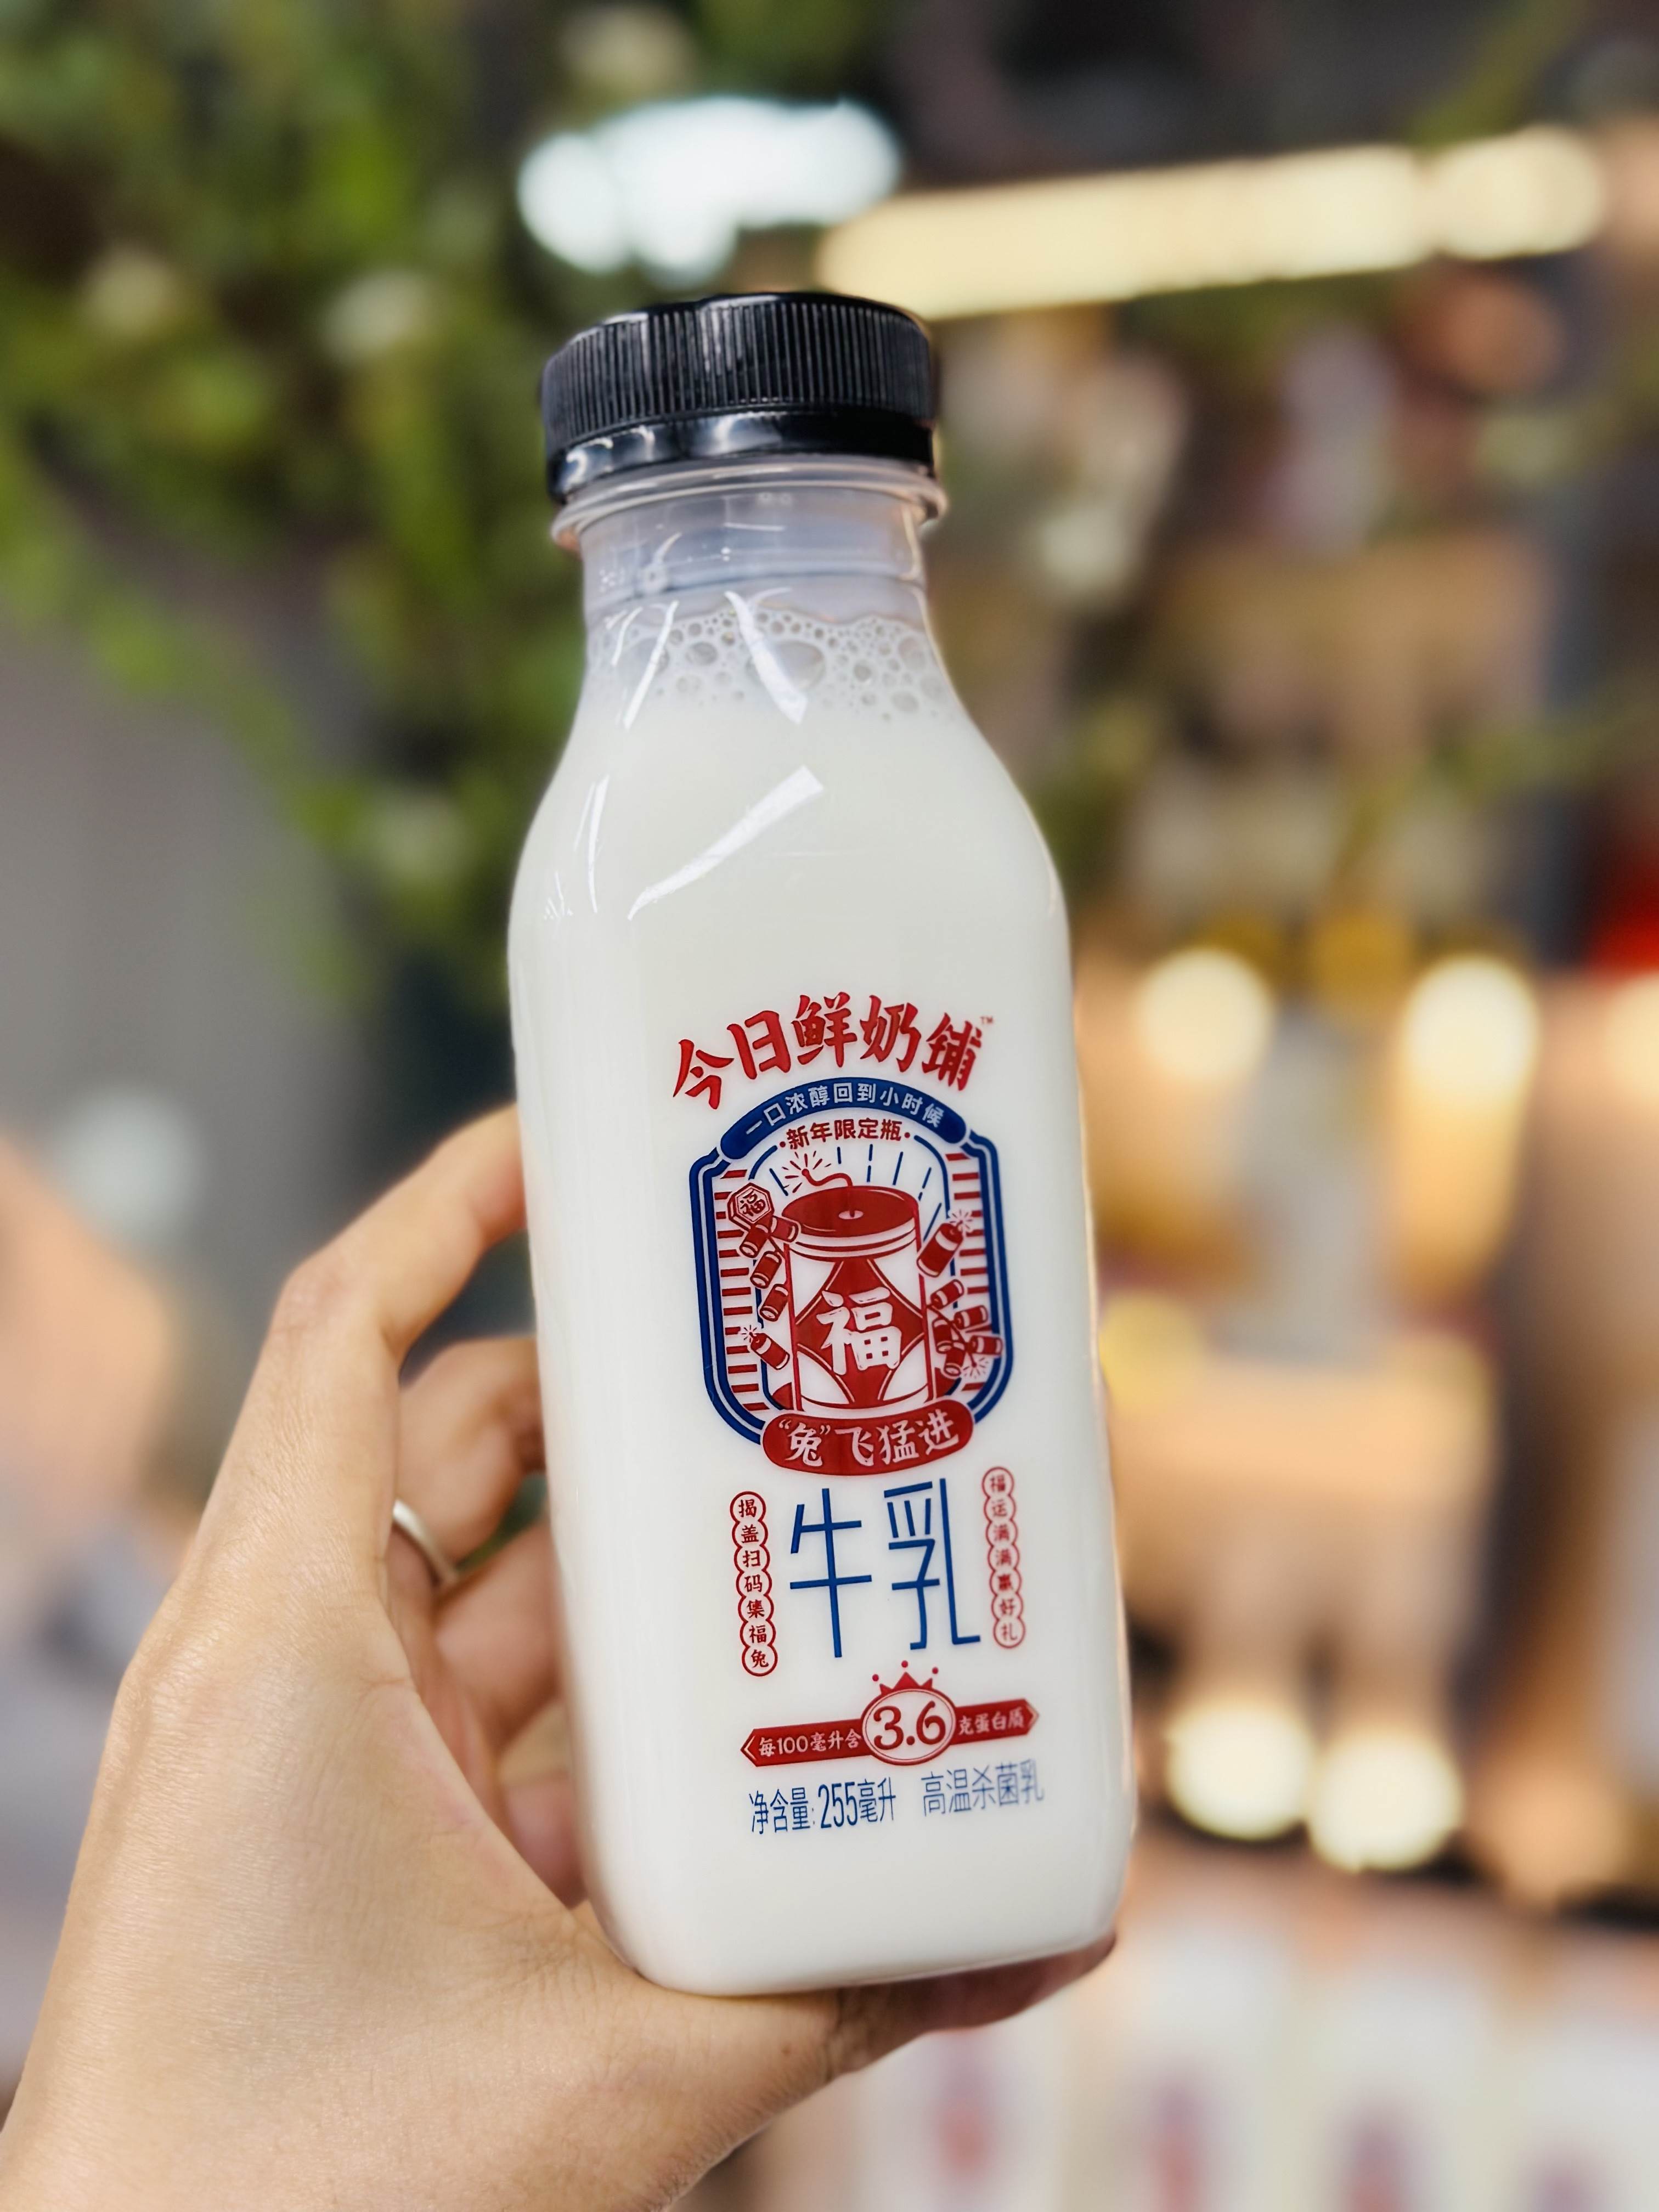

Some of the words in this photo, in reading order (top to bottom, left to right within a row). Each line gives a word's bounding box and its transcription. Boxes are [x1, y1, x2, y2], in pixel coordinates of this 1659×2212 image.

[673, 992, 983, 1109] 今日鲜奶铺
[746, 1082, 944, 1135] 一口浓醇回到小时候
[786, 1118, 902, 1150] 新年限定瓶
[816, 1287, 902, 1376] 福
[737, 1498, 770, 1669] 揭盖扫码集福兔
[790, 1478, 981, 1658] 牛乳
[758, 1730, 862, 1757] 每100毫升含
[873, 1701, 946, 1750] 3.6
[958, 1707, 1025, 1736] 克蛋白质
[921, 1758, 1045, 1816] 高温杀菌乳
